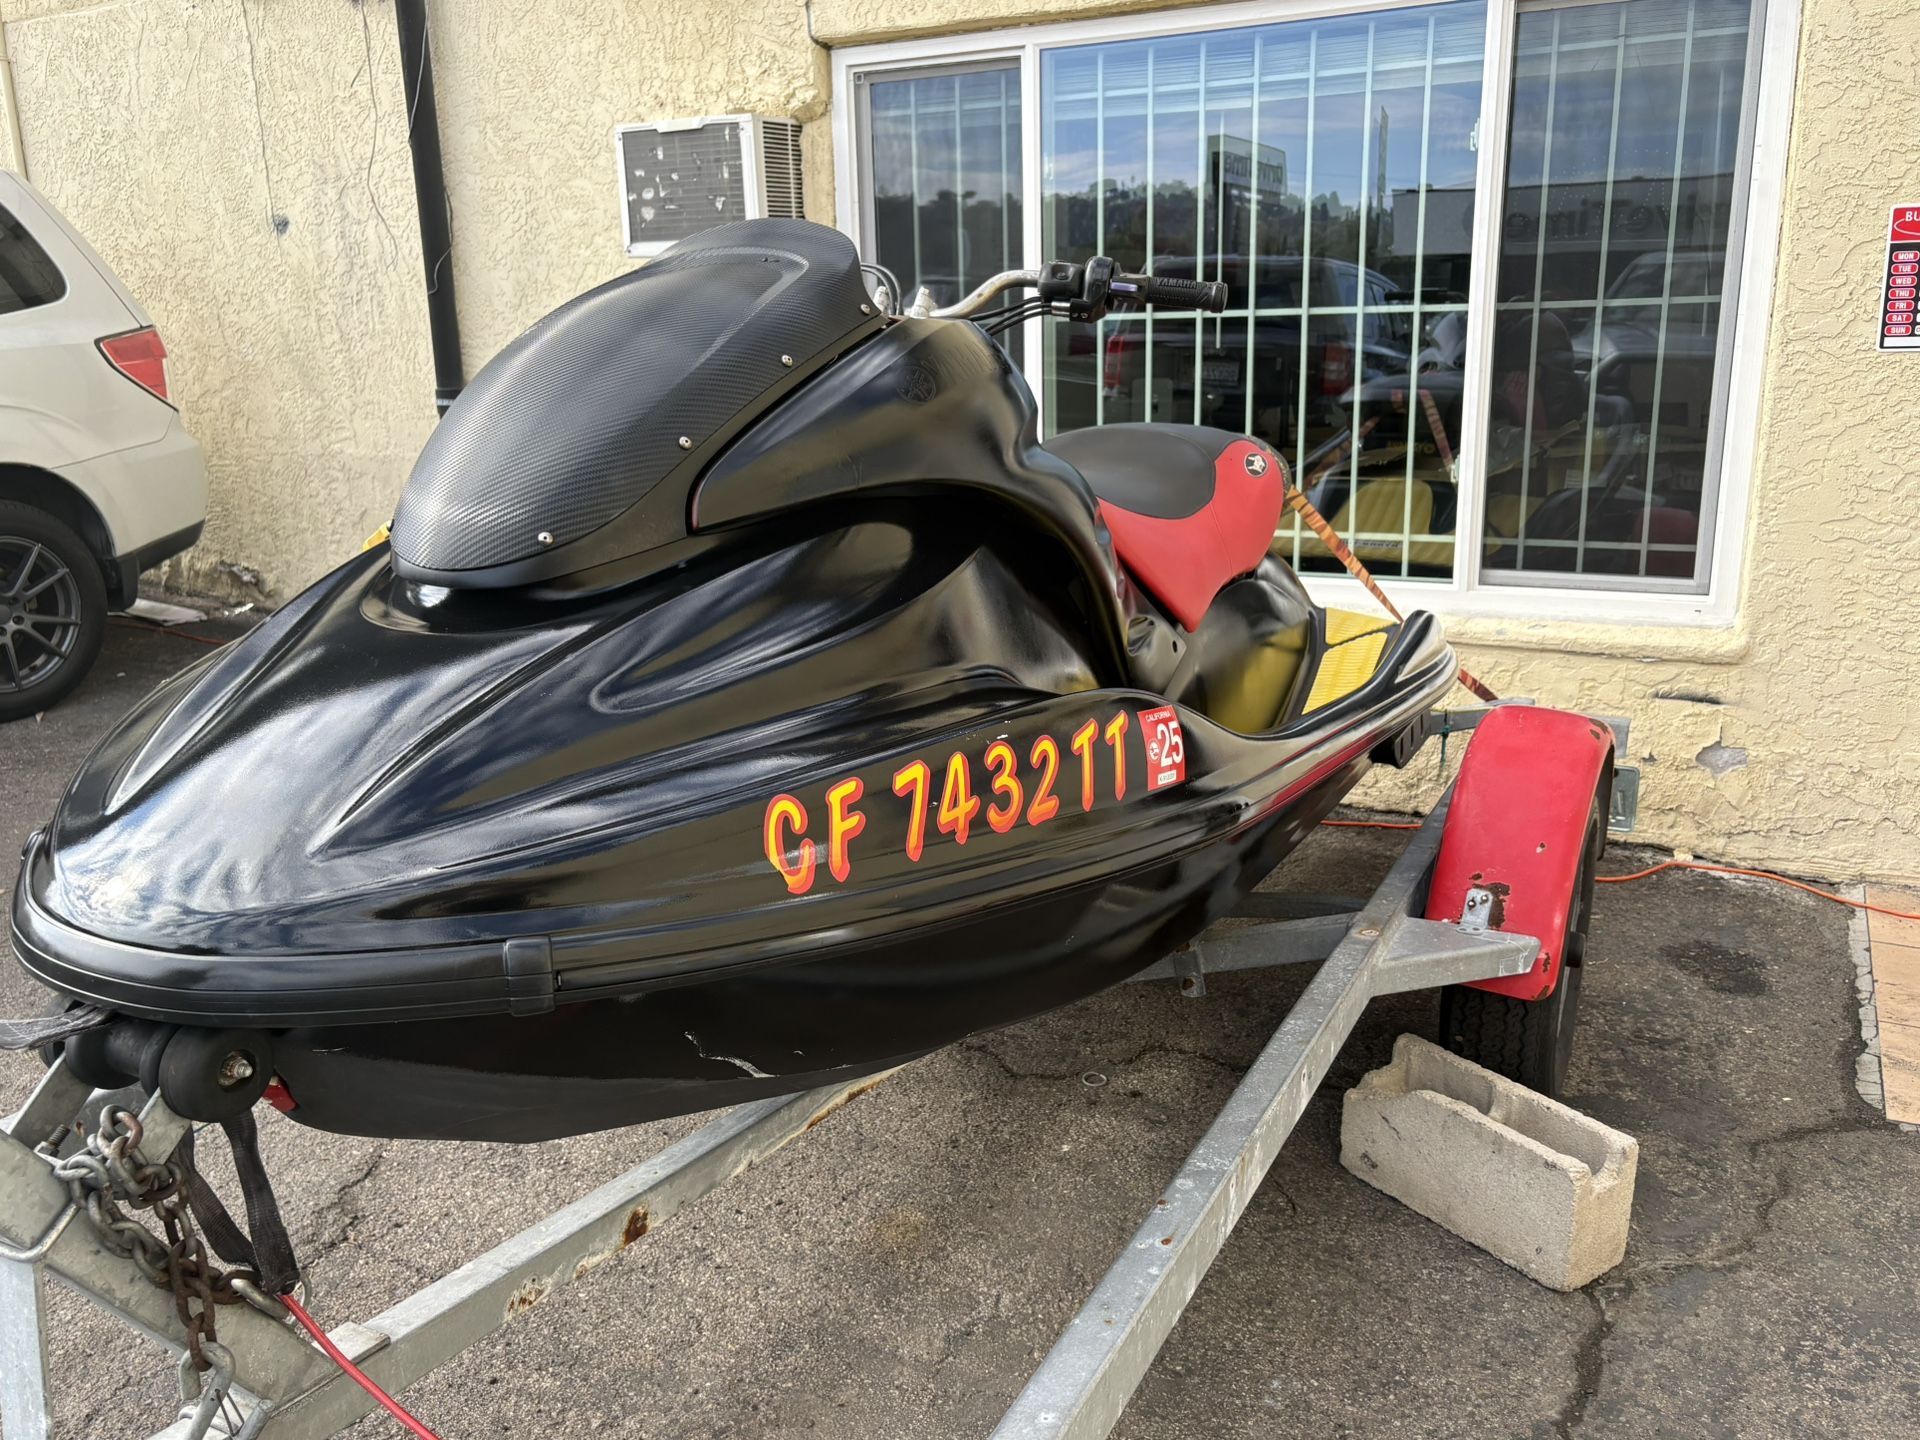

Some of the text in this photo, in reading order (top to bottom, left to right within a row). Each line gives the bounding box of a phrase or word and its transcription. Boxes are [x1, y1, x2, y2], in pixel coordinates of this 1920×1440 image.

[1898, 251, 1914, 260] MON
[1898, 263, 1911, 272] TUE
[1156, 278, 1197, 289] YAMAHA
[1895, 276, 1912, 285] WED
[1895, 289, 1910, 297] THU
[1894, 301, 1907, 309] FRI
[1892, 313, 1907, 322] SAT
[1890, 326, 1906, 334] SUN
[1145, 710, 1171, 723] CALIFORNIA
[1157, 720, 1183, 768] 25
[763, 776, 866, 894] CF
